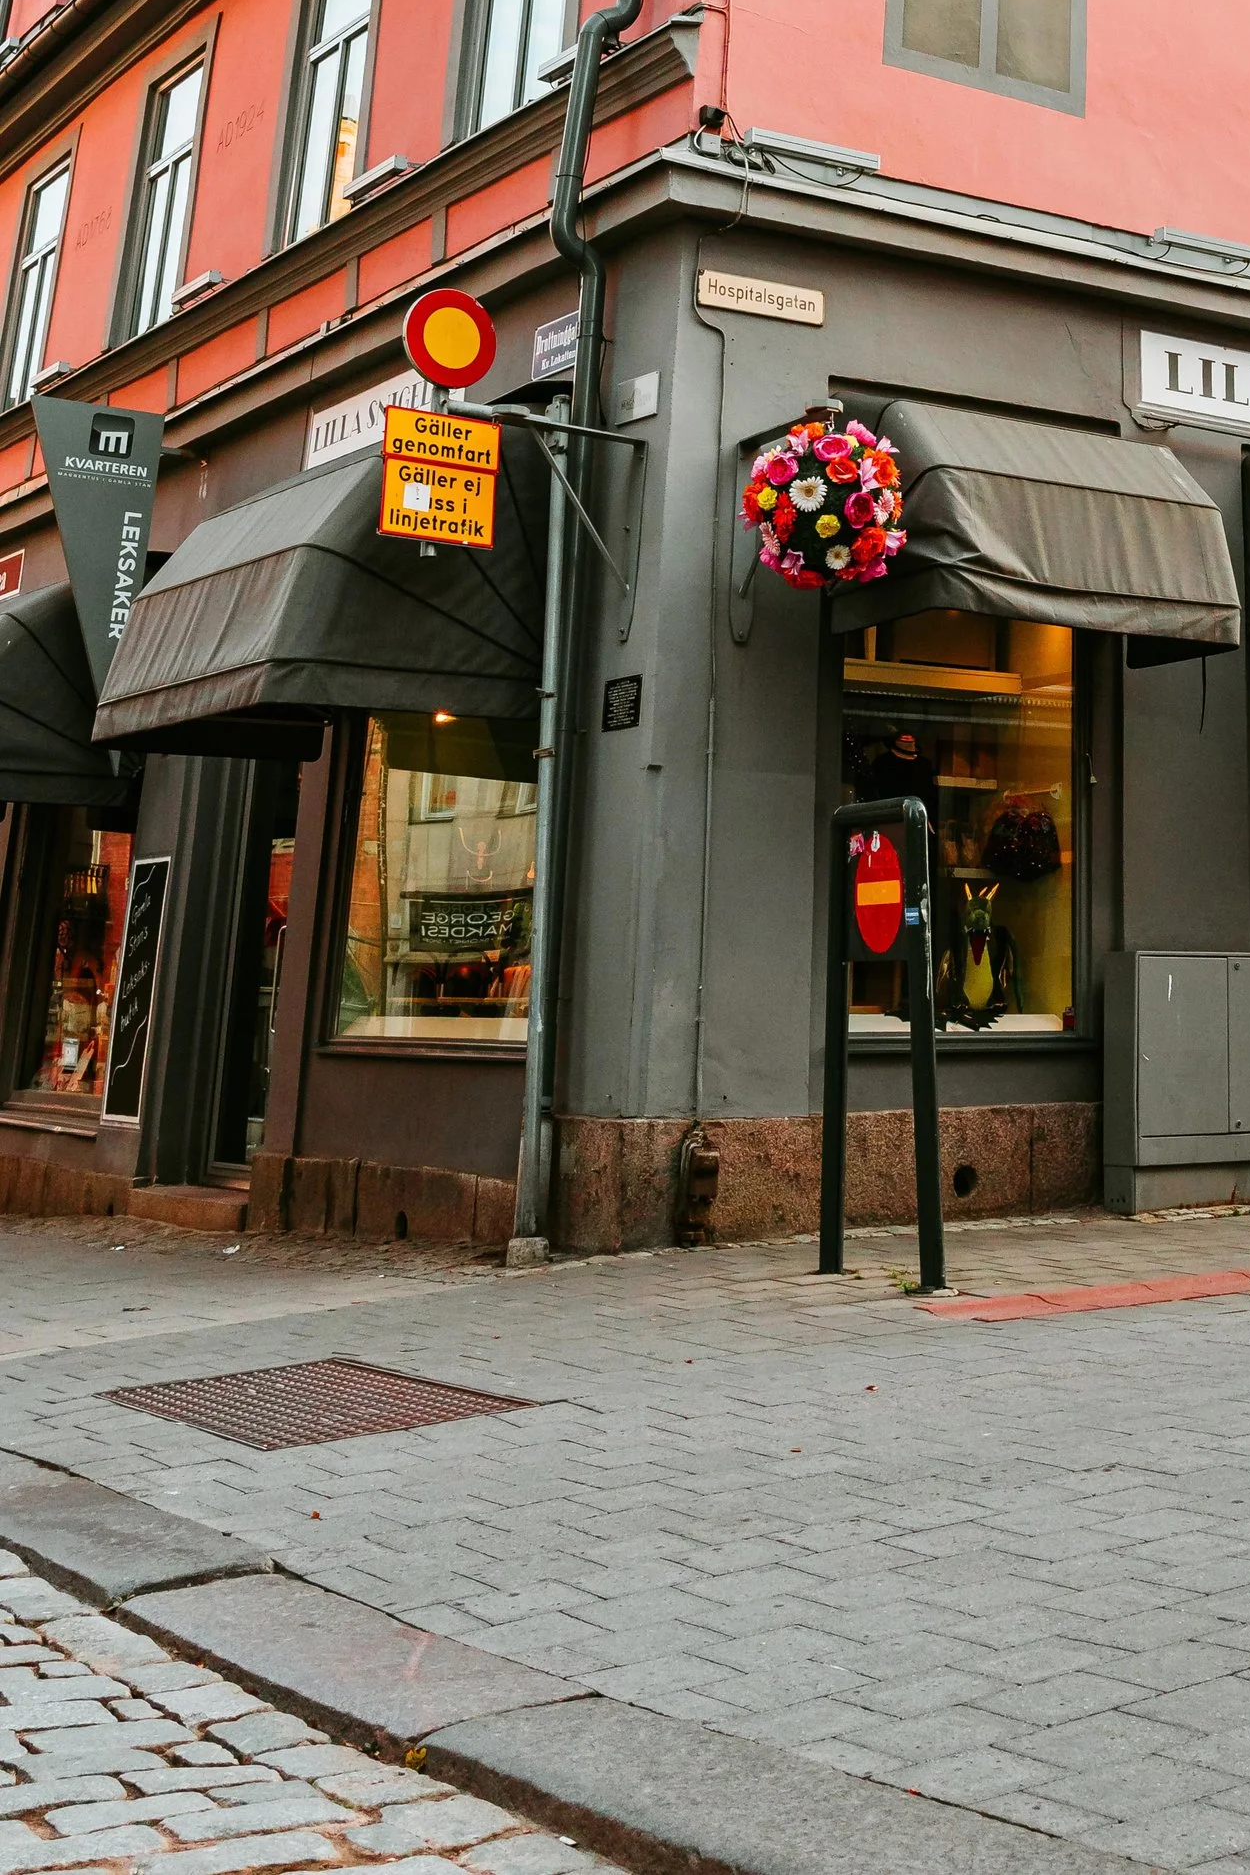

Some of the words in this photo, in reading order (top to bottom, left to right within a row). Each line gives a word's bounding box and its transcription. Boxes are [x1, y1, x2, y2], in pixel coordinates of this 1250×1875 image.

[708, 278, 816, 312] Hospitalsgatan
[312, 409, 362, 453] LILLA
[415, 418, 472, 441] Gäller
[392, 437, 491, 465] genomfart
[65, 456, 148, 478] KVARTEREN
[399, 466, 457, 489] Gäller
[464, 477, 481, 496] ej
[463, 498, 468, 514] i
[390, 508, 484, 537] linjetrafik
[108, 511, 142, 639] LEKSAKER
